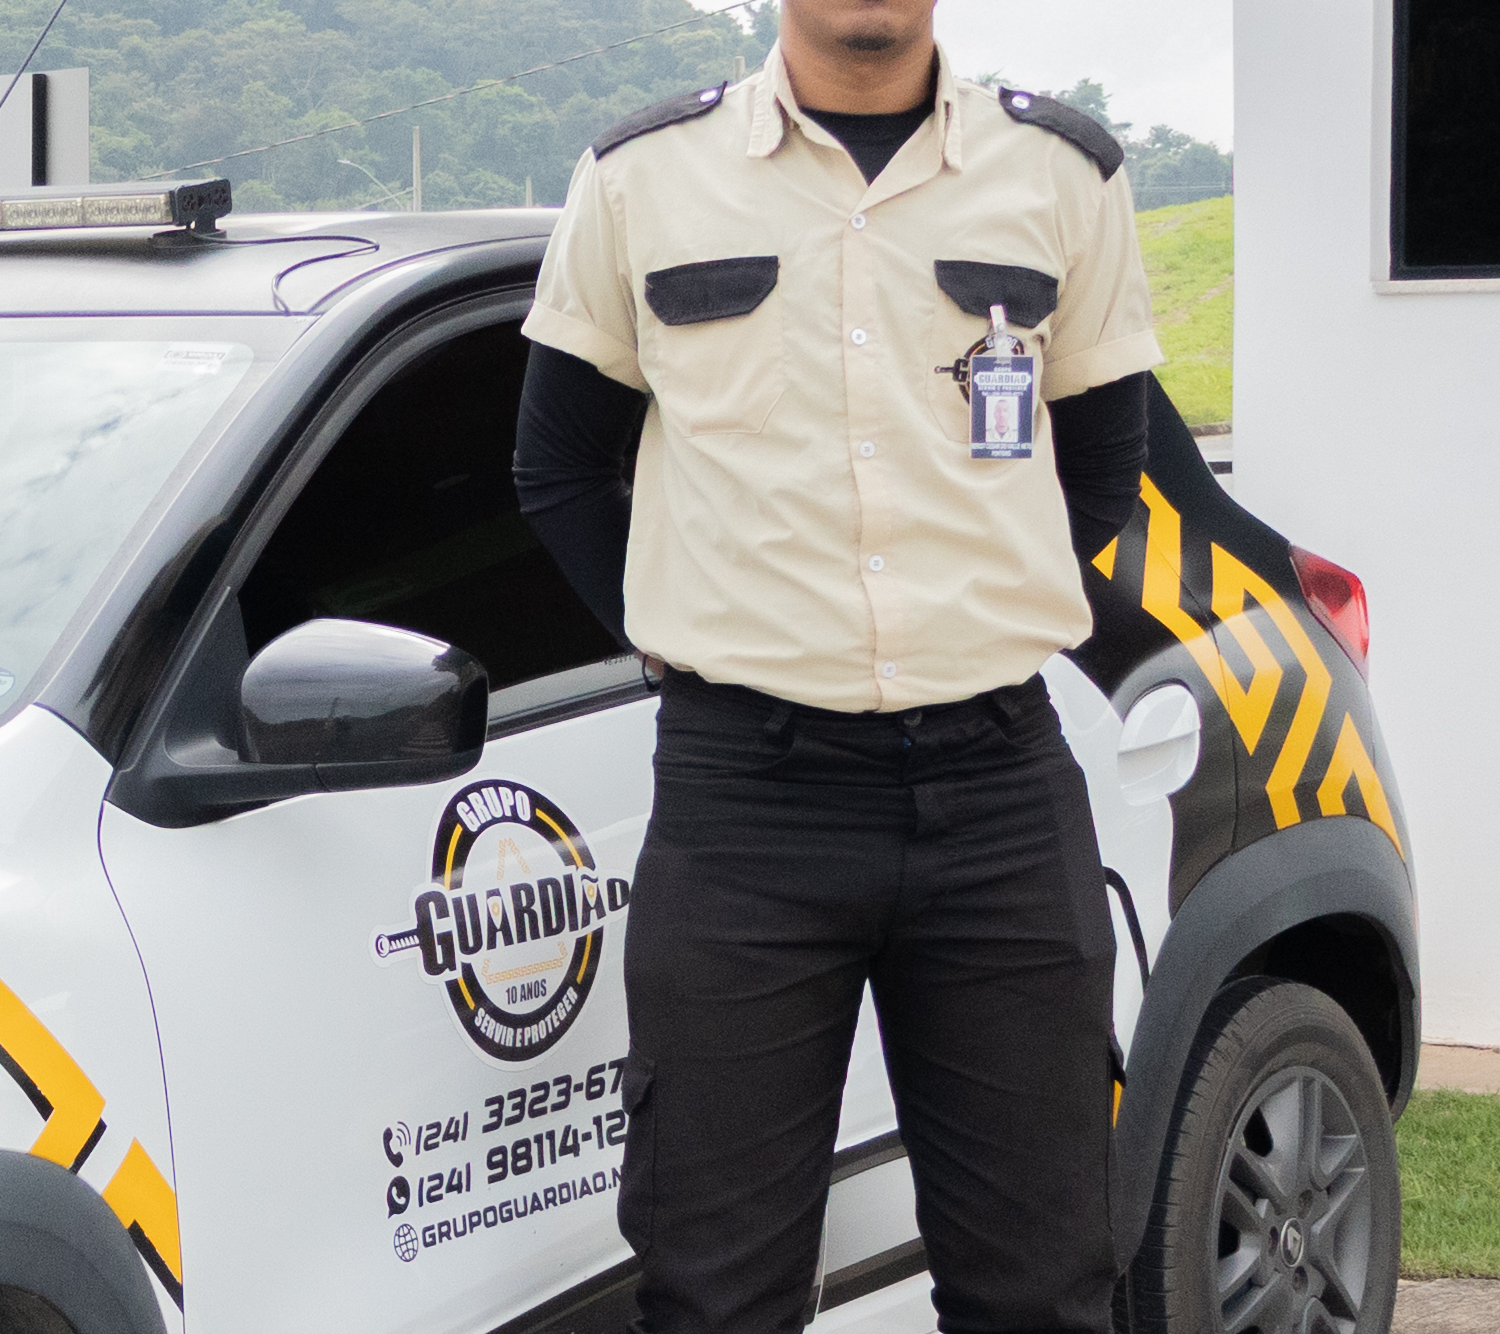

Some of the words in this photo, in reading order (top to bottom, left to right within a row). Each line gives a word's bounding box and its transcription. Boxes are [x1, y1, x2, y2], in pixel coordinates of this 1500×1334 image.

[456, 786, 532, 833] GRUPO
[415, 873, 630, 976] GUARDIÃO
[474, 1007, 514, 1047] SERVIR
[515, 1028, 523, 1048] E
[524, 986, 578, 1046] PROTEGER
[504, 985, 518, 1006] 10
[519, 978, 548, 1003] ANOS
[482, 1056, 629, 1134] 3323-67
[486, 1109, 627, 1185] 98114-12
[421, 1167, 622, 1249] GRUPOGUARDIAO.N
